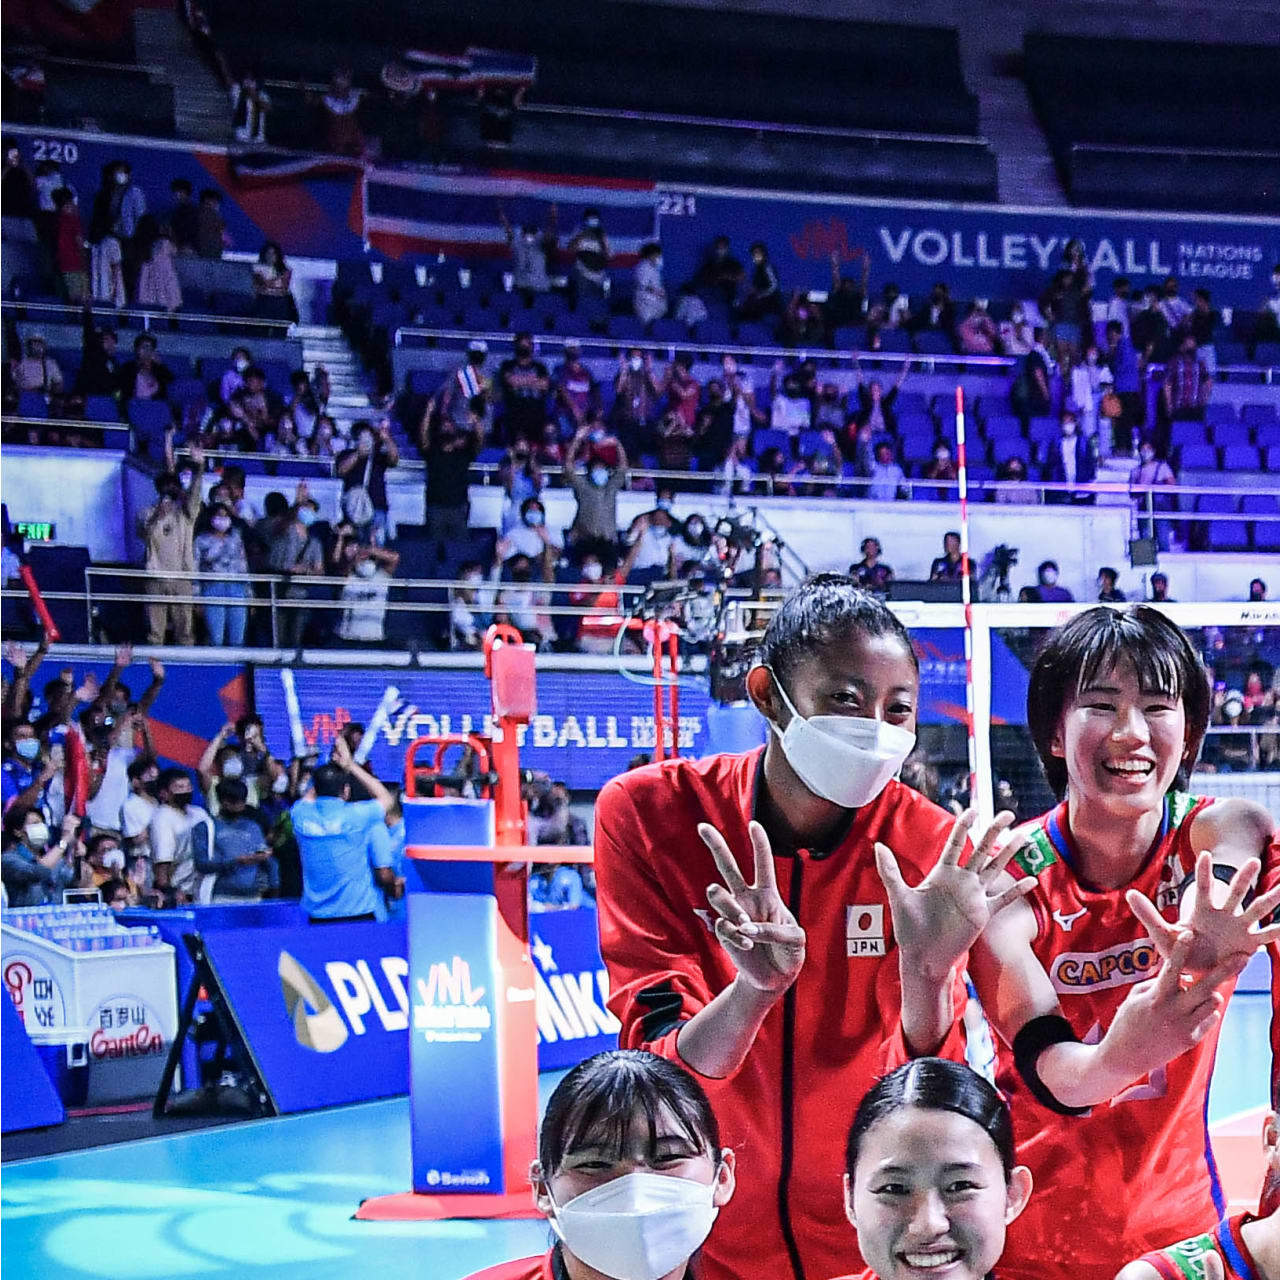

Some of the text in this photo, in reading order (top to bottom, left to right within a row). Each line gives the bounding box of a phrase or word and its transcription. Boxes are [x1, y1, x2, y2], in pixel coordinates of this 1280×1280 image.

[33, 139, 78, 164] 220
[880, 226, 1171, 276] VOLLEYALL
[851, 941, 879, 954] JPN
[1056, 946, 1160, 986] CAPCO
